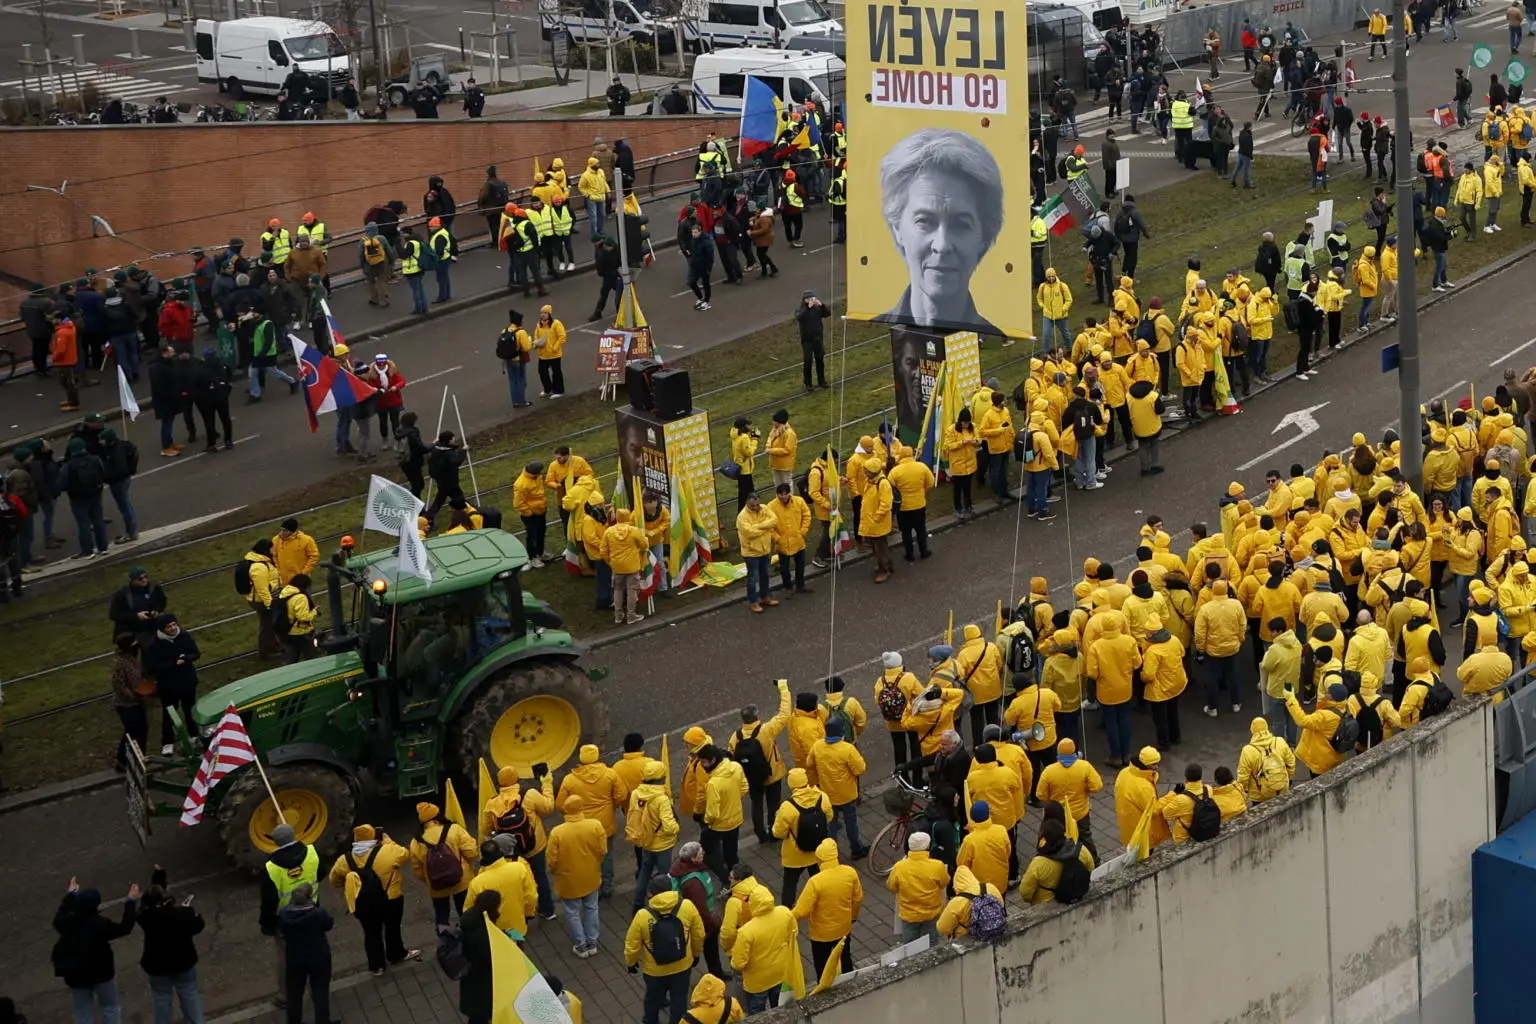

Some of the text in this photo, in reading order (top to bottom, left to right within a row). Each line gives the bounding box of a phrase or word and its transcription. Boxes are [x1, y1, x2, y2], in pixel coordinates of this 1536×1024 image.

[600, 337, 611, 348] NO
[643, 452, 665, 472] PLAN
[645, 477, 669, 494] EUROPE
